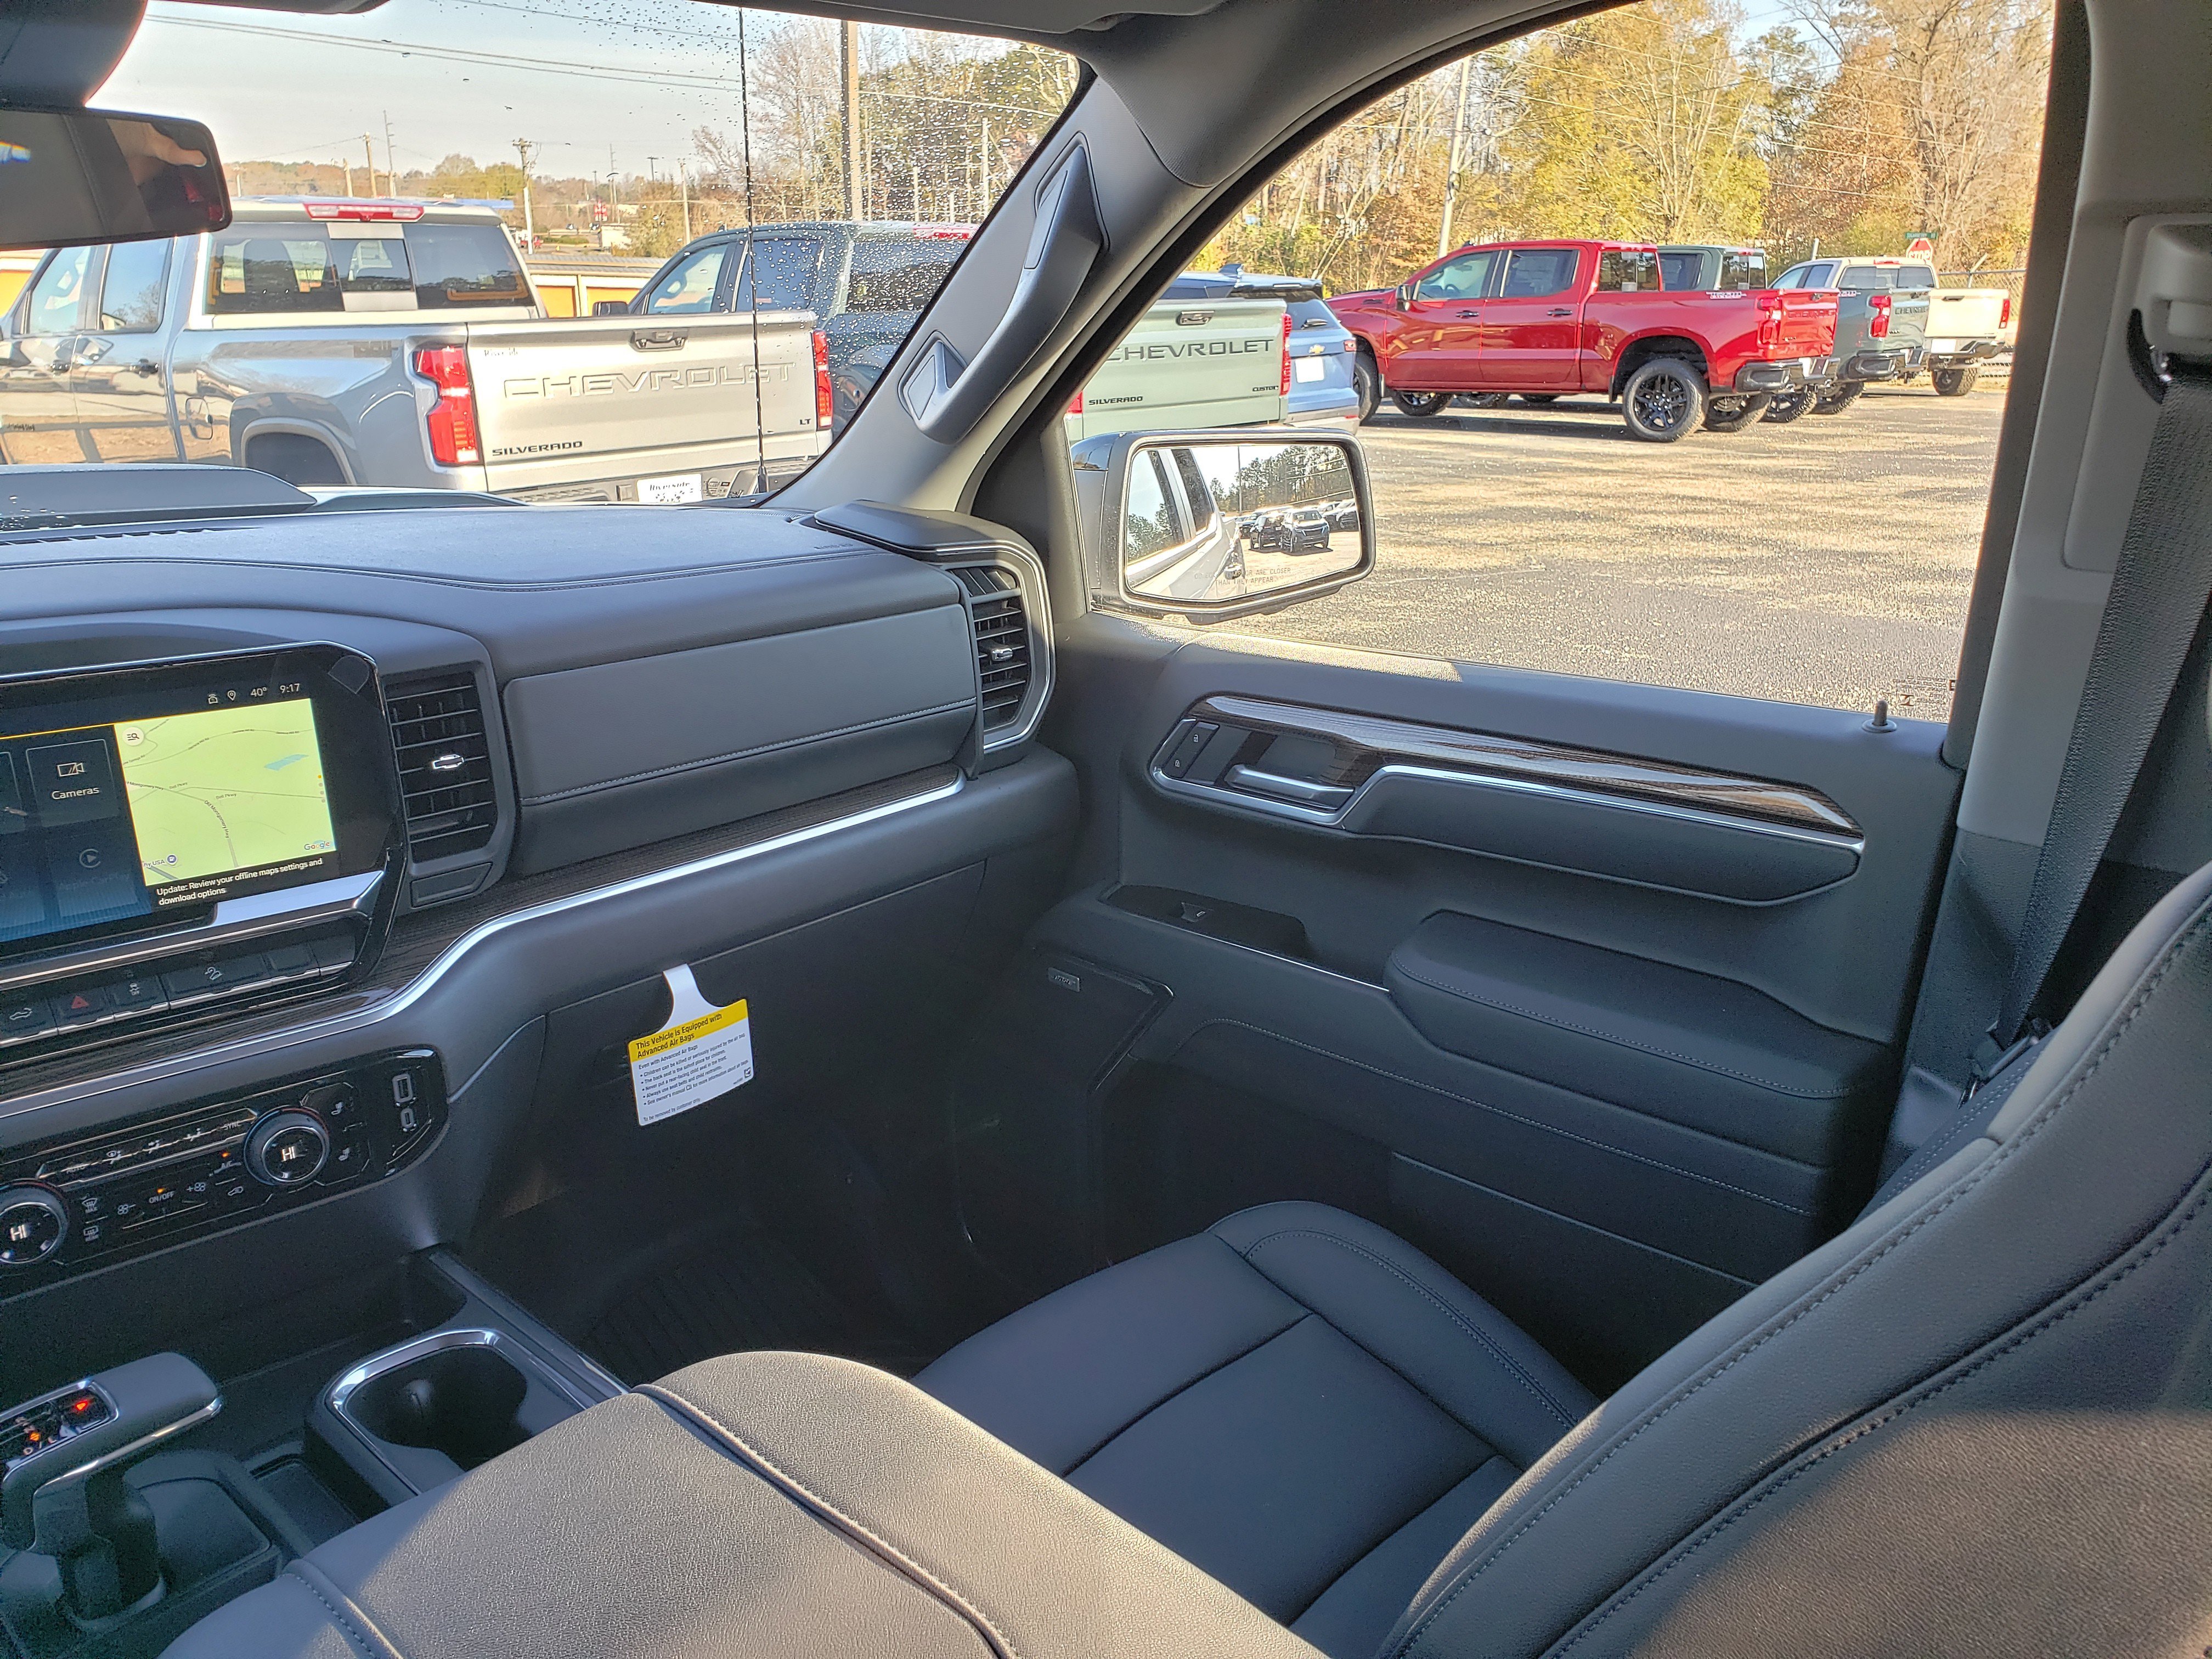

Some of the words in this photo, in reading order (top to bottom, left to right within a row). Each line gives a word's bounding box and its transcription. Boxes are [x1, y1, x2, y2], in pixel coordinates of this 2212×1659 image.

[1909, 250, 1931, 261] STOP
[504, 362, 796, 398] CHEVROLET
[1088, 396, 1143, 405] SILVERADO
[492, 441, 583, 456] SILVERADO
[250, 687, 267, 697] 40°
[280, 683, 300, 693] 9:17
[52, 786, 100, 800] Cameras
[211, 805, 227, 829] Montgomery
[304, 840, 330, 850] Google
[156, 885, 188, 896] Update:
[189, 878, 216, 889] Review
[216, 876, 233, 885] your
[235, 871, 258, 881] offline
[258, 867, 279, 876] maps
[280, 862, 308, 872] settings
[309, 858, 323, 866] and
[159, 893, 196, 905] download
[197, 887, 227, 899] options
[636, 1041, 650, 1049] This
[651, 1032, 674, 1044] Vehicle
[681, 1018, 708, 1033] Equipped
[709, 1014, 722, 1023] with
[637, 1042, 668, 1058] Advanced
[669, 1039, 678, 1047] Air
[680, 1033, 695, 1043] Bags
[644, 1068, 661, 1076] Children
[692, 1049, 709, 1058] seriously
[661, 1051, 680, 1061] Advanced
[672, 1087, 686, 1096] manual
[708, 1070, 727, 1081] information
[654, 1109, 670, 1118] removed
[676, 1101, 692, 1110] customer
[223, 1120, 241, 1131] SYNC
[282, 1146, 295, 1161] HI
[149, 1190, 174, 1204] ON/OFF
[10, 1224, 26, 1241] HI
